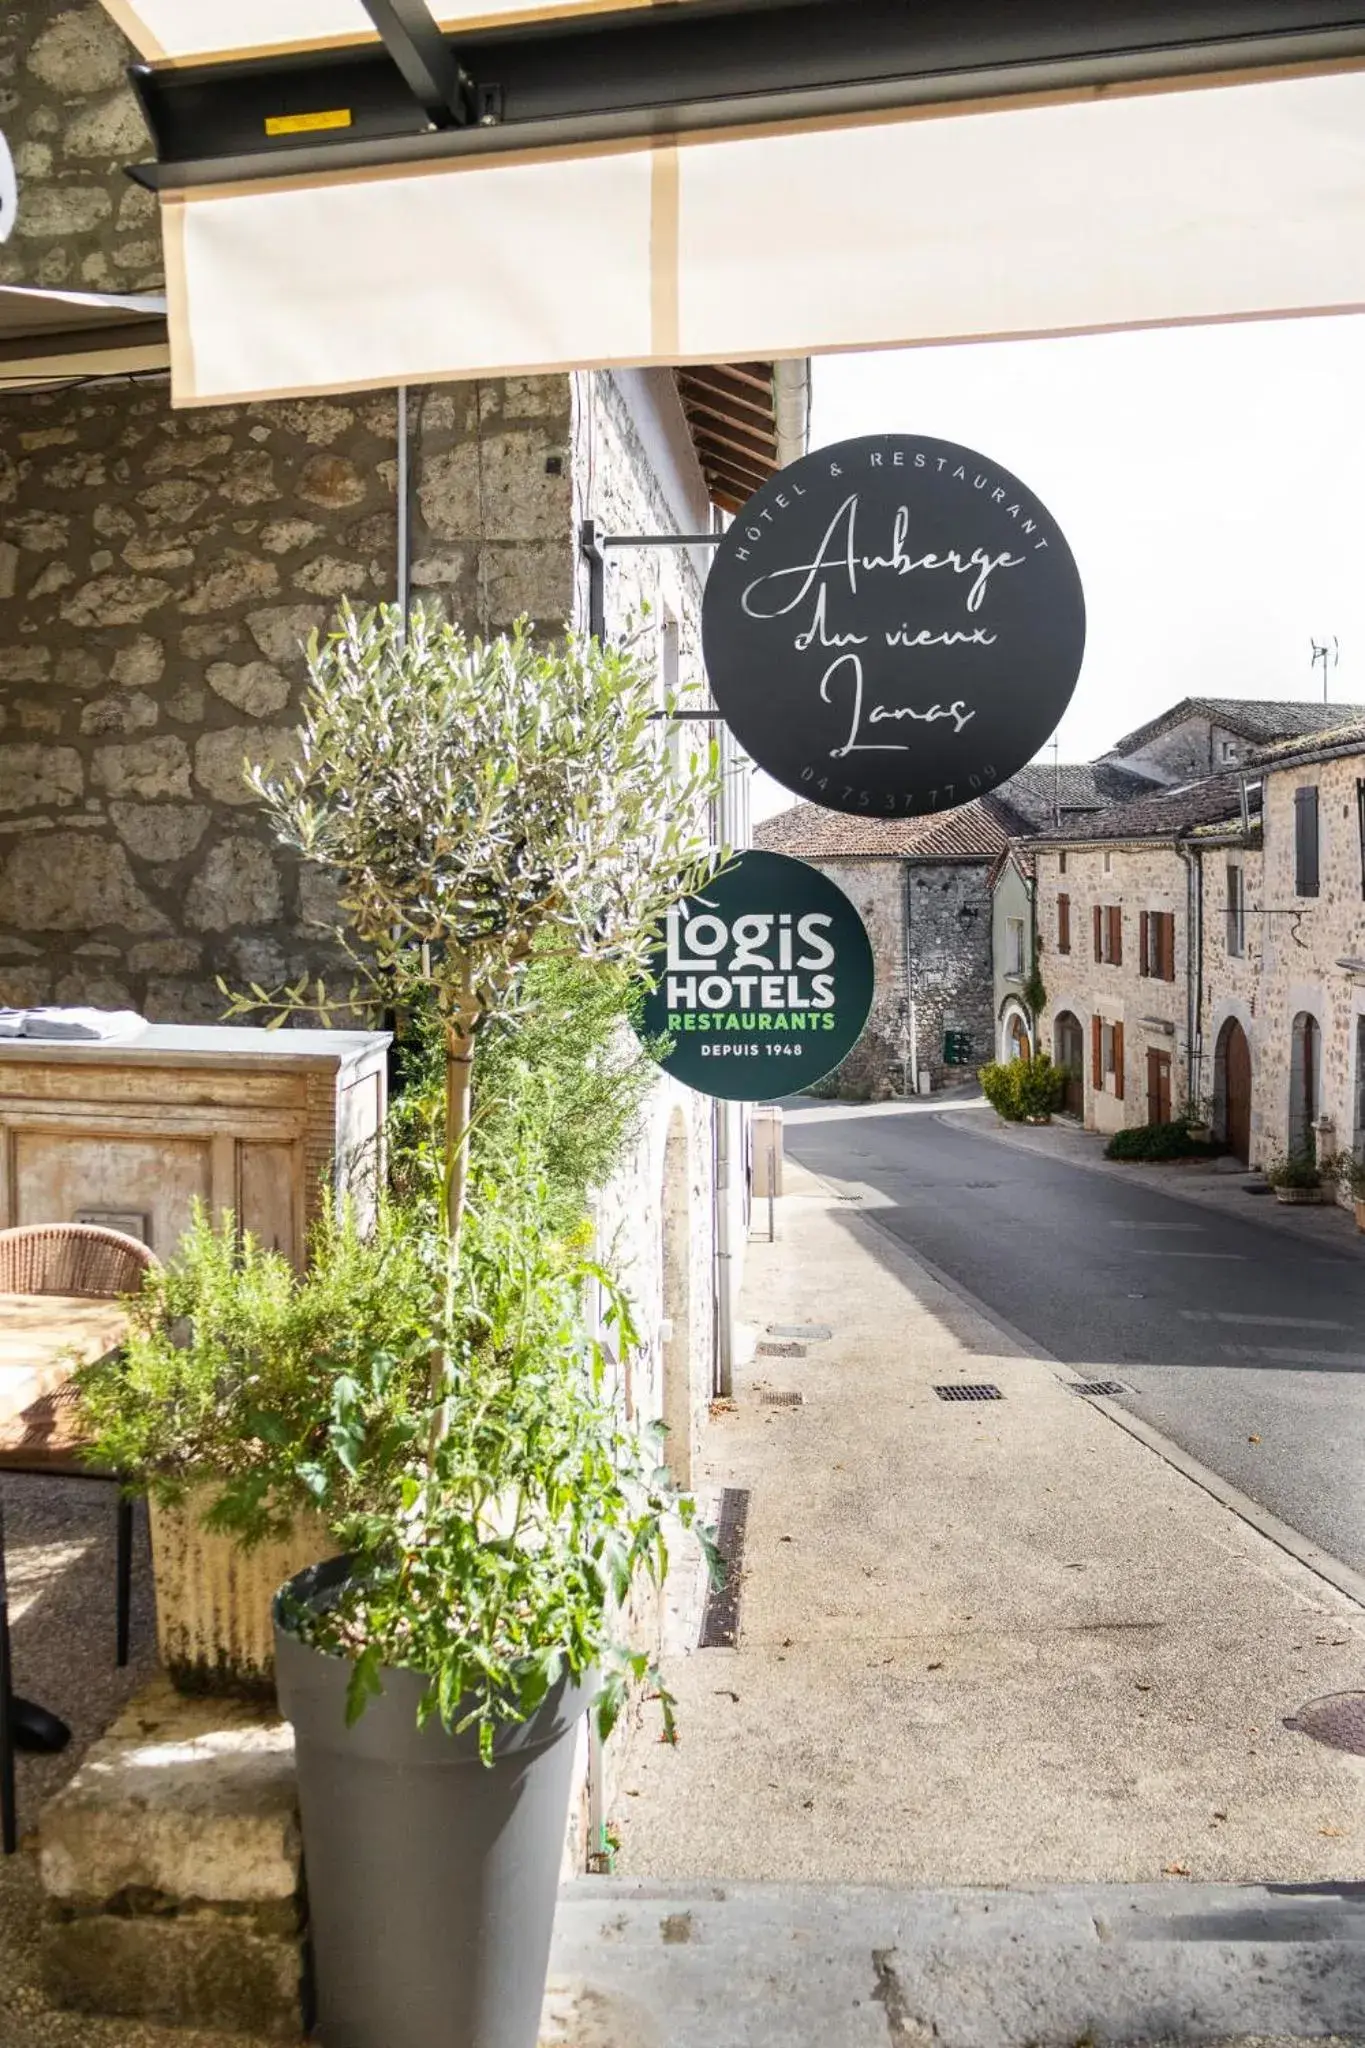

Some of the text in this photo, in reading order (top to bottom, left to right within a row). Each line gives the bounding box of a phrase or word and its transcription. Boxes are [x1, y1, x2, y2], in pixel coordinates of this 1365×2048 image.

[735, 452, 1049, 561] HÔTEL & RESTAURANT
[741, 493, 1026, 619] Auberge
[795, 582, 998, 651] du vieux
[820, 653, 976, 758] Lanas
[800, 764, 997, 810] 04 75 37 77 09
[667, 974, 835, 1009] HOTELS
[668, 1013, 835, 1031] RESTAURANTS
[701, 1044, 802, 1056] DEPUIS 1948
